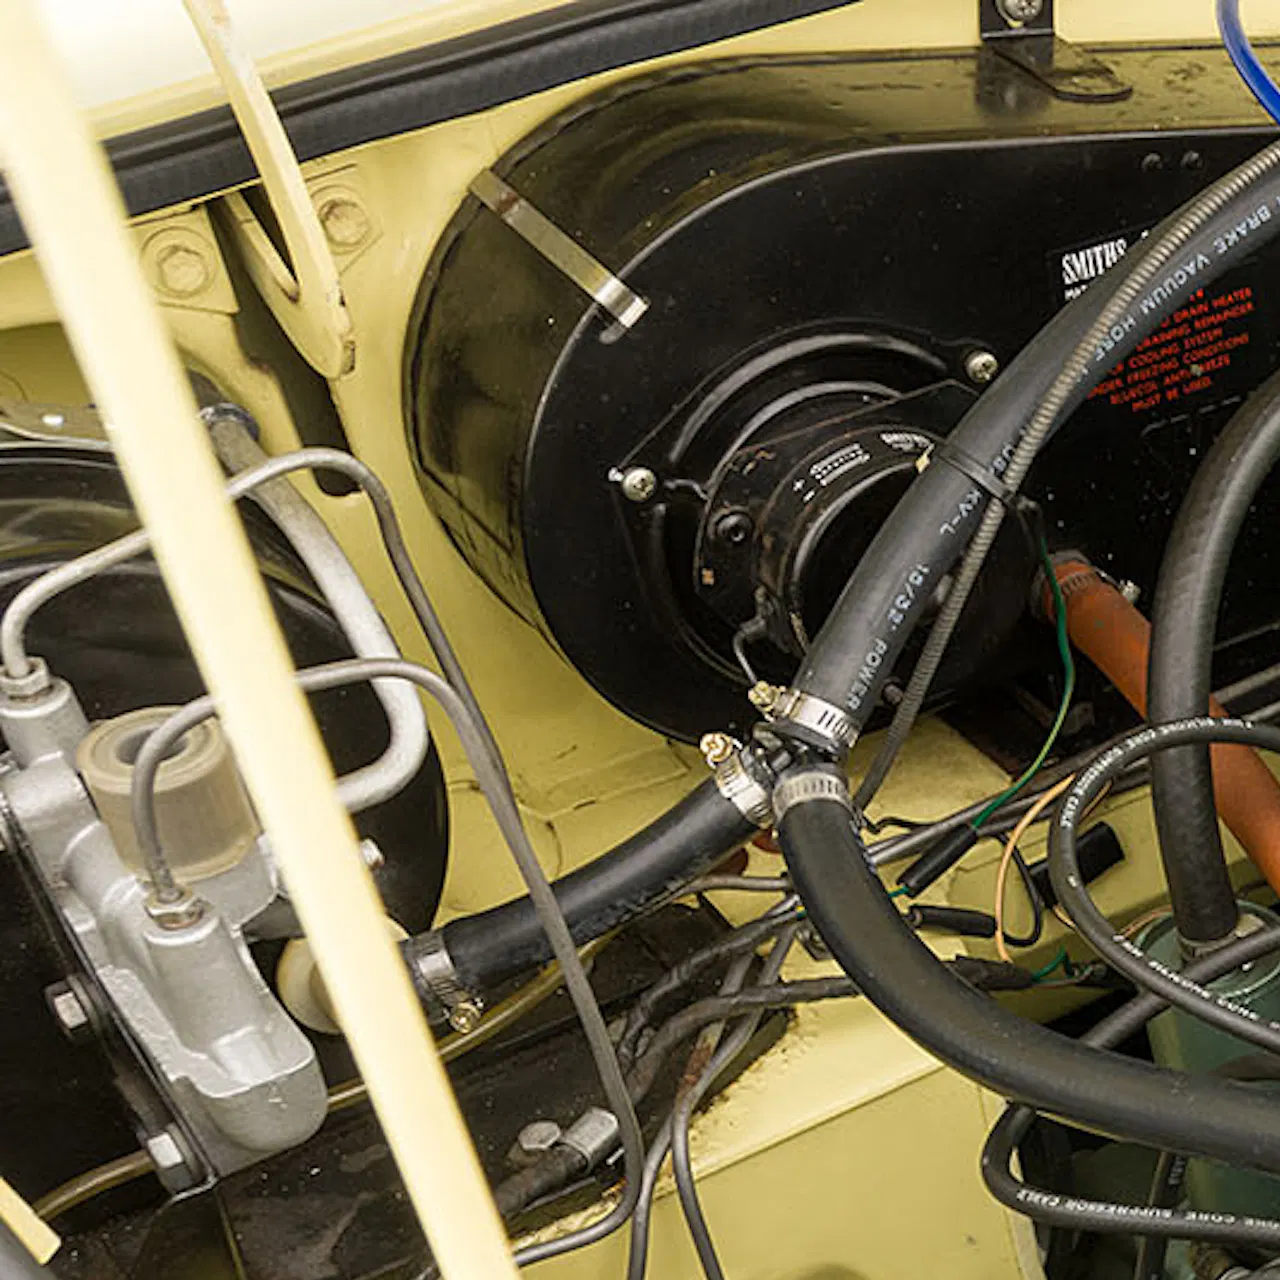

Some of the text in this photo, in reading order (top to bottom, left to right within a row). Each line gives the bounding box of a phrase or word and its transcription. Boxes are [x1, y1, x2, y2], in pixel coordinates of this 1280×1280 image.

[1213, 203, 1272, 254] BRAKE
[1140, 253, 1212, 315] VACUUM
[847, 637, 888, 711] POWER
